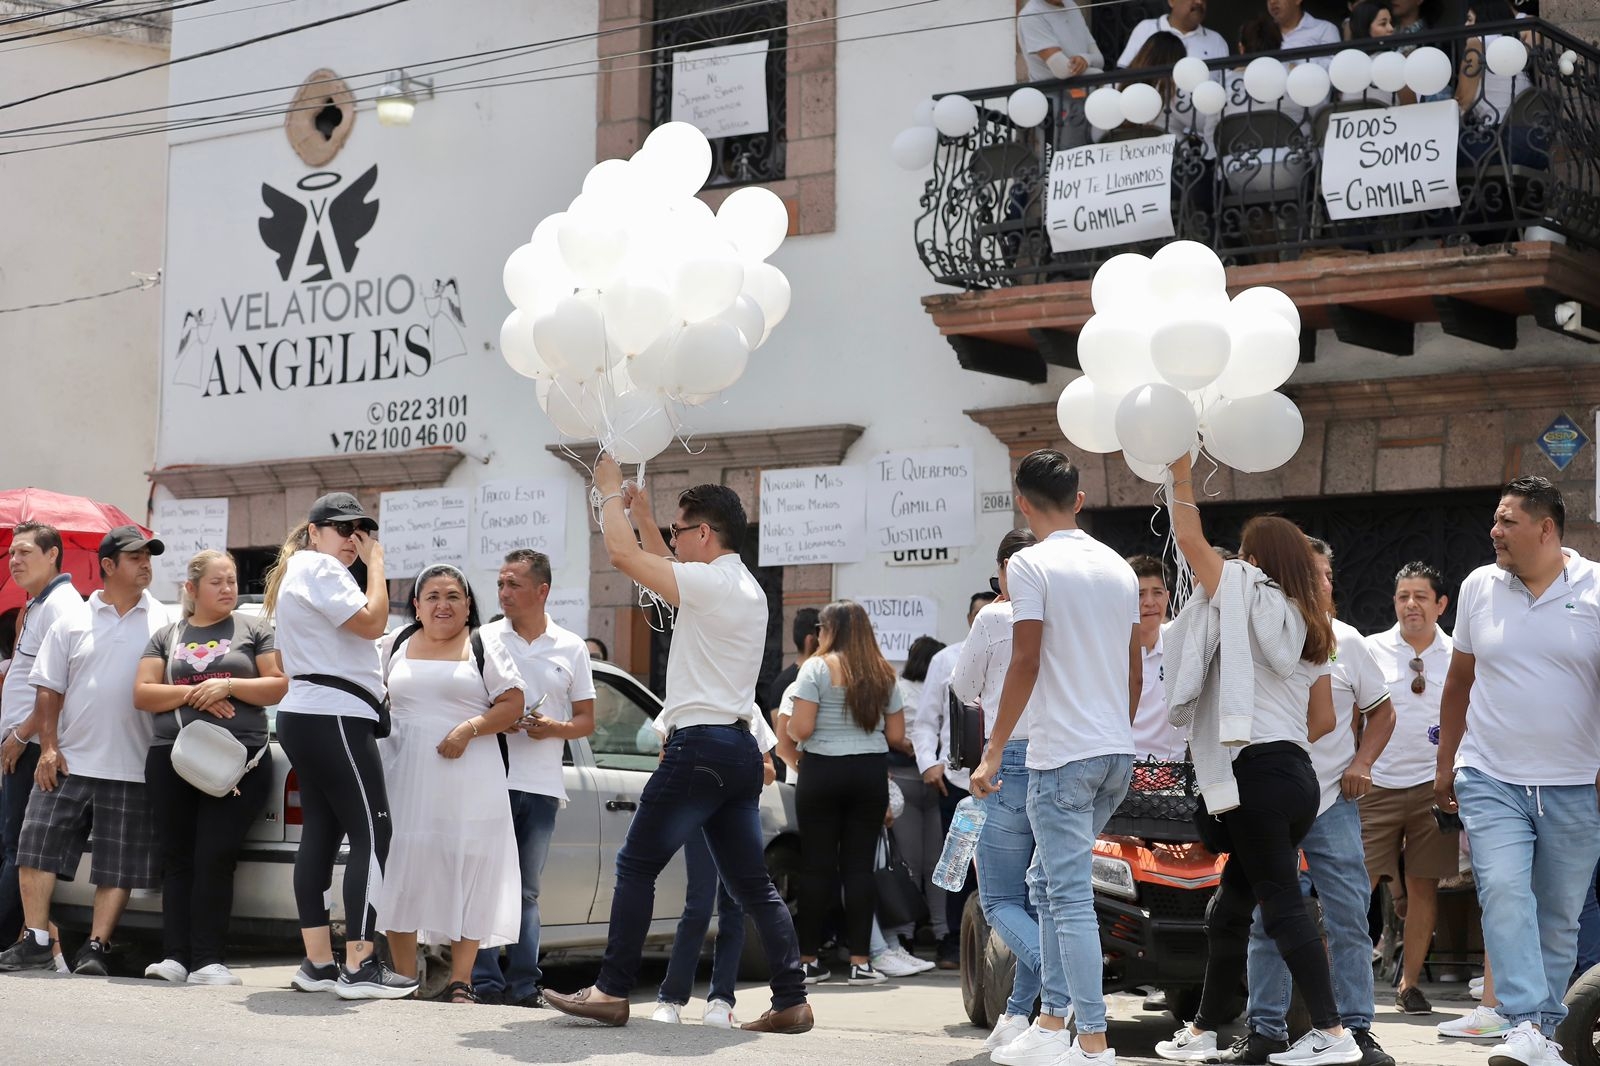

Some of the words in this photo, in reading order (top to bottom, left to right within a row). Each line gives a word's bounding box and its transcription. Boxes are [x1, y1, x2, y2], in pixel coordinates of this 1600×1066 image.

[1331, 116, 1397, 139] TODOS
[1055, 150, 1095, 171] AYER
[1098, 148, 1114, 163] TE
[1359, 139, 1440, 169] SOMOS
[1053, 179, 1082, 200] HOY
[1085, 176, 1102, 193] TE
[1346, 178, 1426, 211] CAMILA
[1074, 202, 1136, 232] CAMILA
[221, 274, 415, 331] VELATORIO
[202, 324, 432, 397] ANGELES
[387, 399, 422, 423] 622
[815, 473, 843, 489] MAS
[876, 460, 896, 481] TE
[902, 457, 968, 482] QUEREMOS
[481, 485, 511, 504] TAXCO
[891, 490, 947, 518] CAMILA
[984, 495, 1011, 509] 208A
[480, 510, 528, 530] CANSADO
[533, 510, 550, 525] DE
[432, 535, 448, 548] NO
[481, 536, 548, 554] ASESINATOS
[879, 525, 943, 546] JUSTICIA
[864, 599, 924, 617] JUSTICIA
